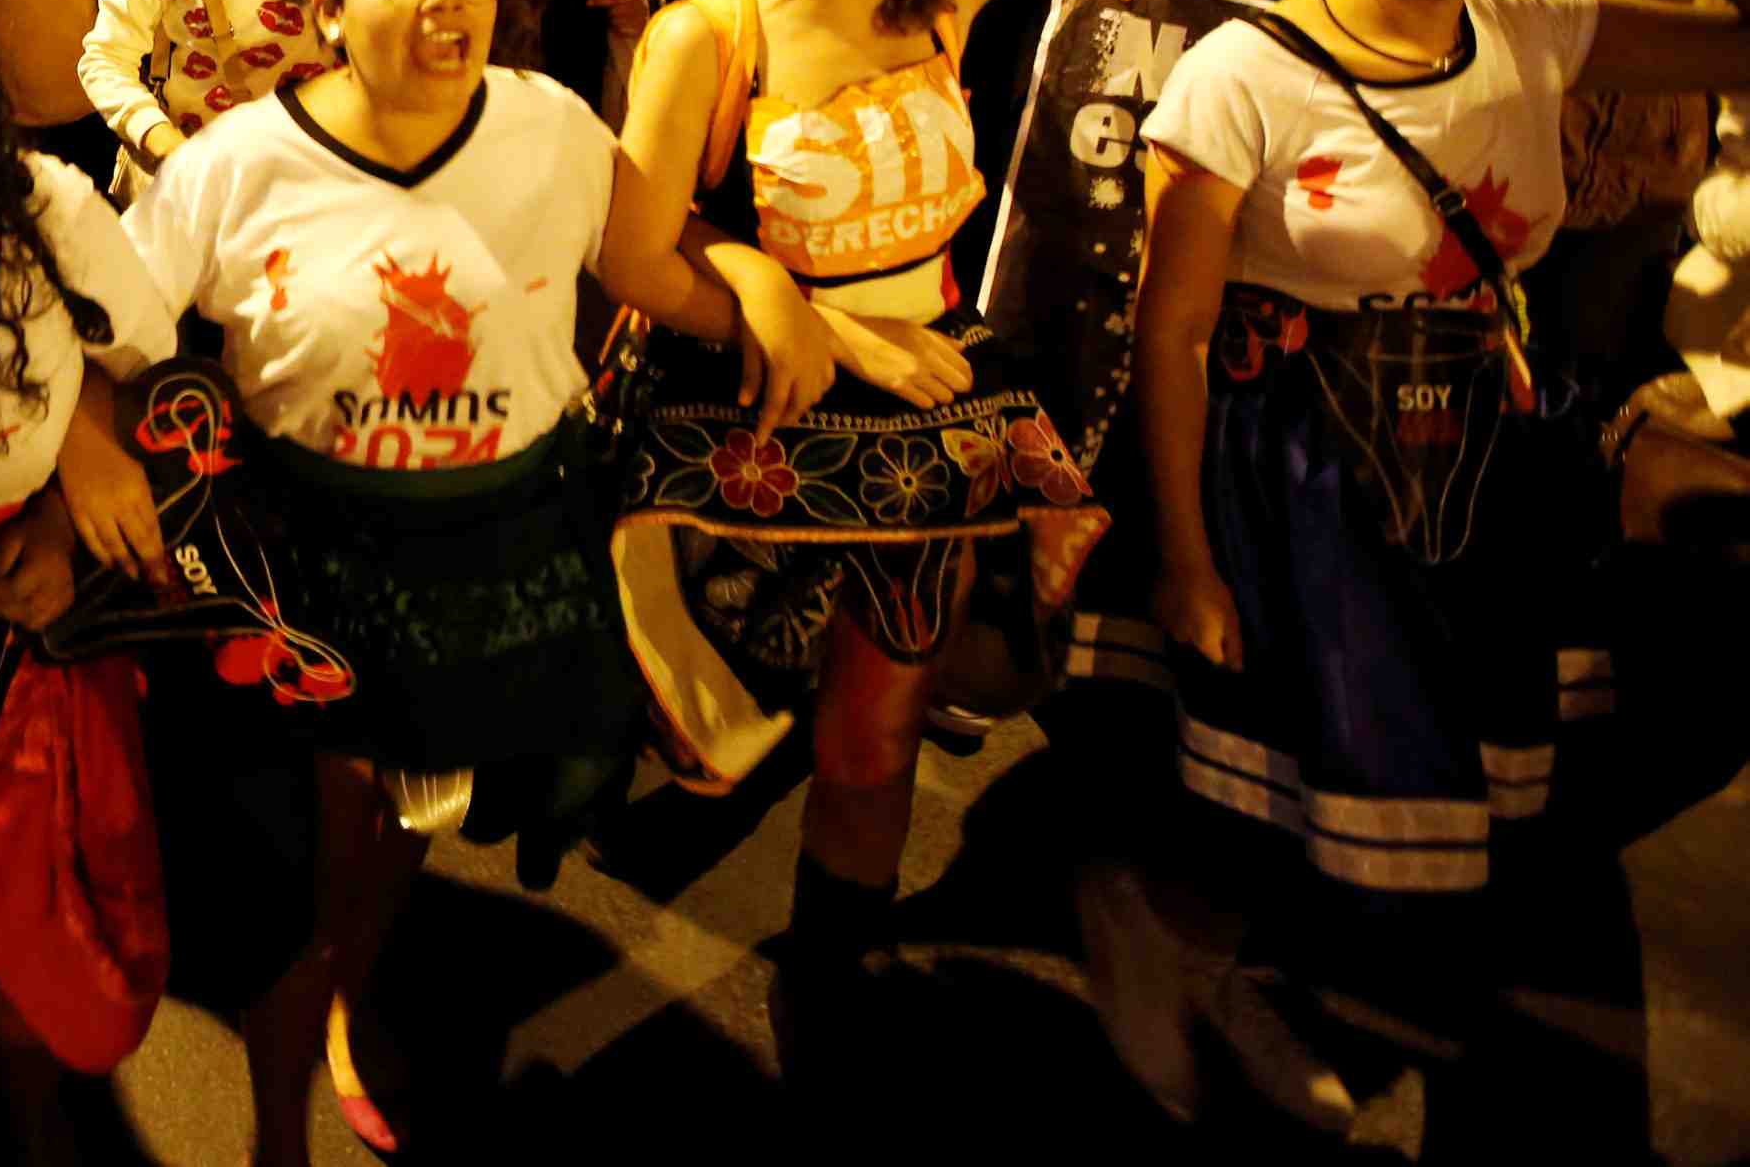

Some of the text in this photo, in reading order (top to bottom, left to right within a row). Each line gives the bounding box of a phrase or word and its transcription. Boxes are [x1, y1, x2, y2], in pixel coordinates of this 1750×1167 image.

[758, 89, 975, 221] SIN
[1396, 382, 1453, 411] SOY
[174, 543, 218, 595] SOY
